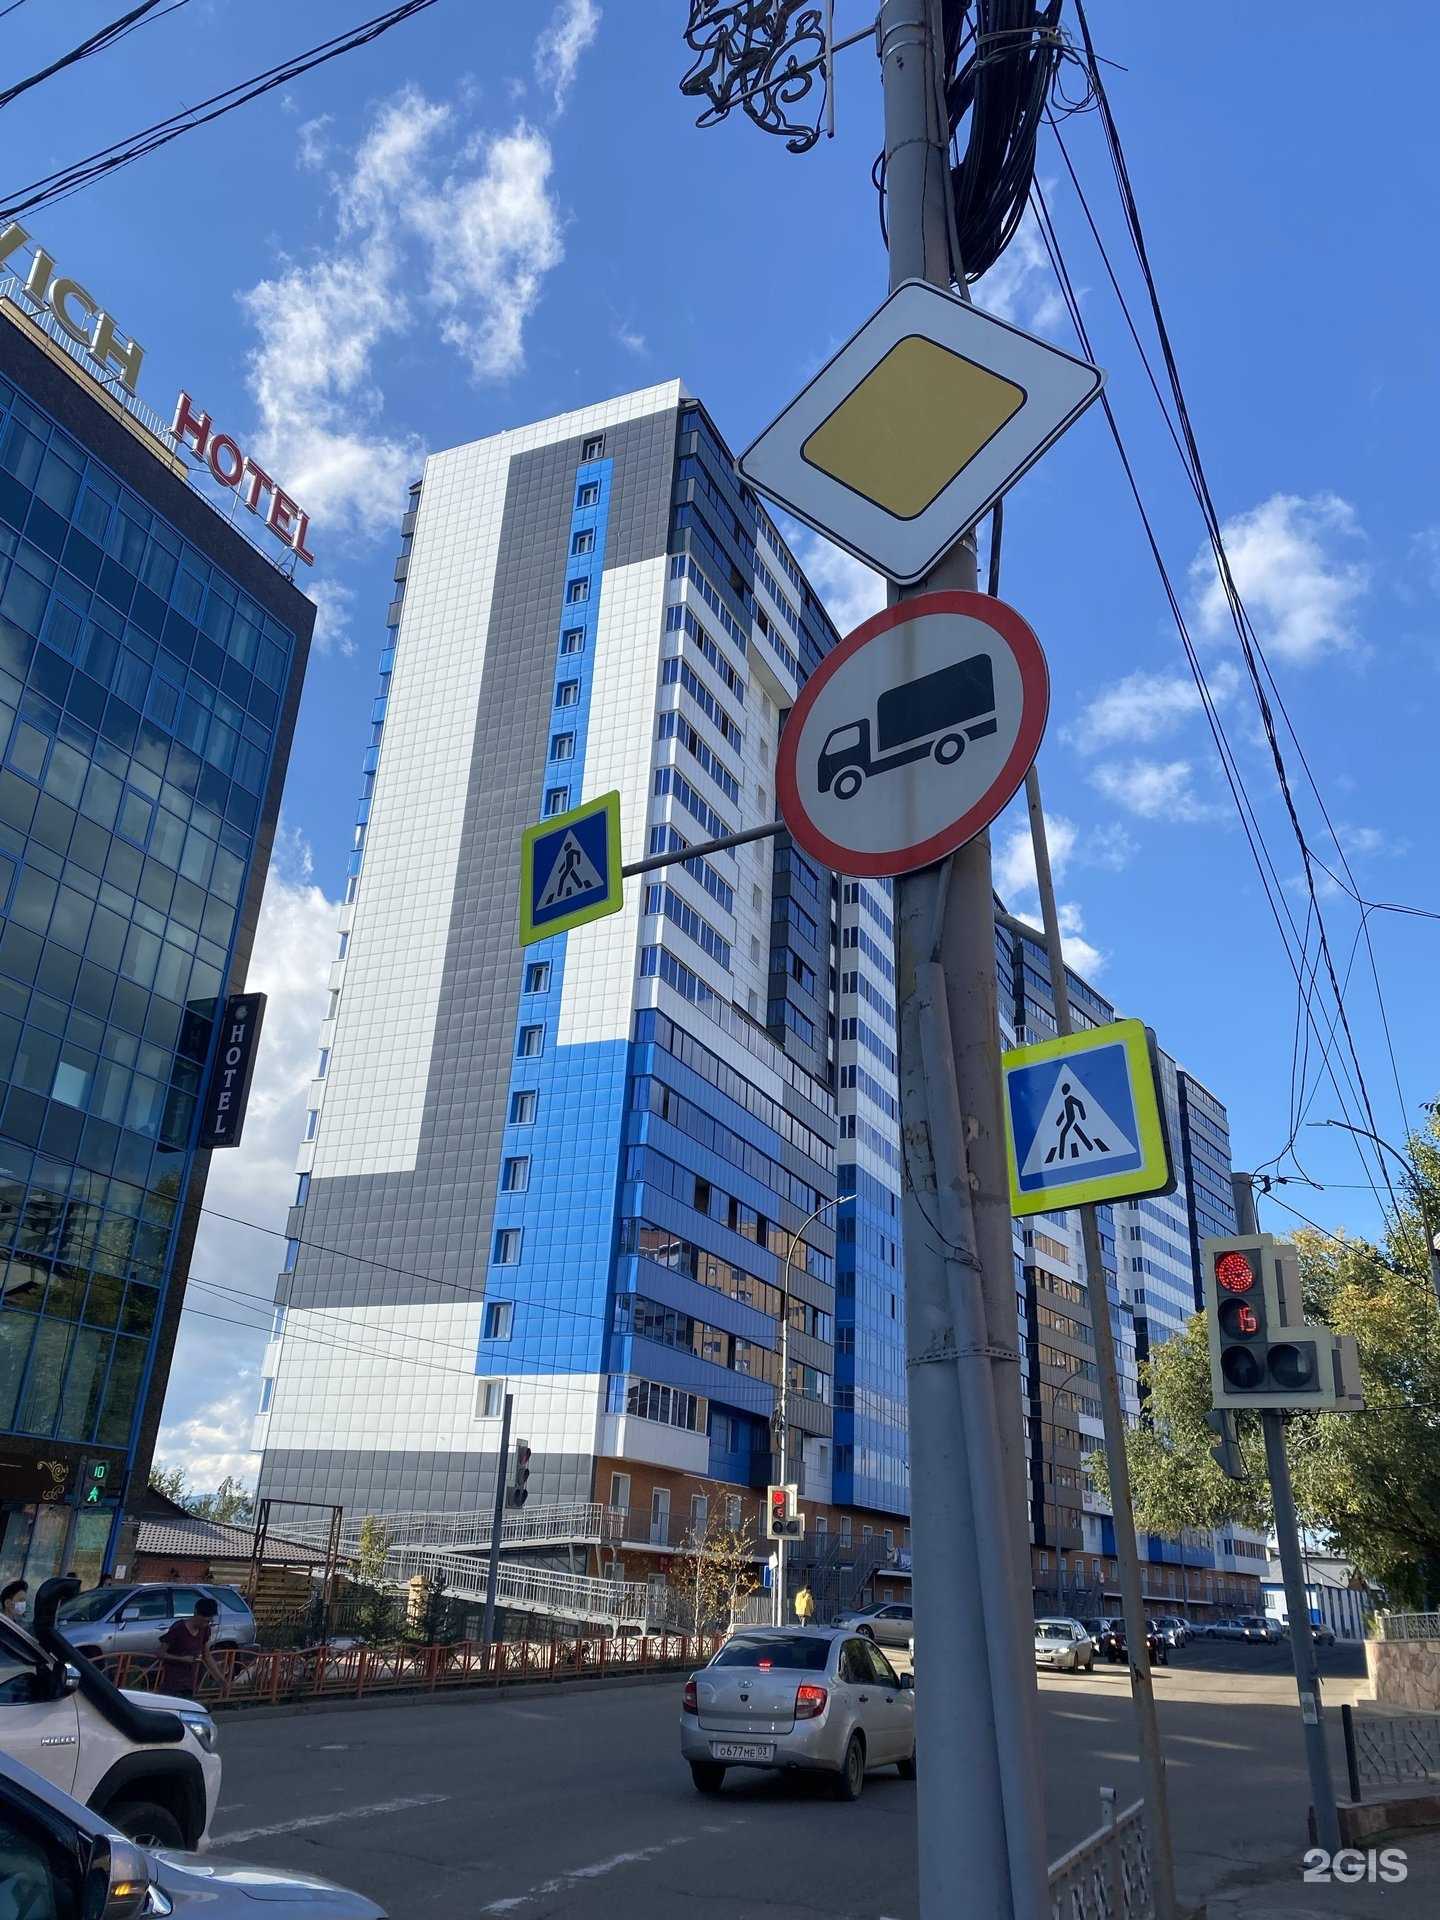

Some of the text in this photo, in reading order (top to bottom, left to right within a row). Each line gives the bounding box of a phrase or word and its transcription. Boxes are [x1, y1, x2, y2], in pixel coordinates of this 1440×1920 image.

[170, 391, 315, 567] HOTEL
[214, 1024, 246, 1134] HOTEL
[94, 1466, 105, 1478] 10
